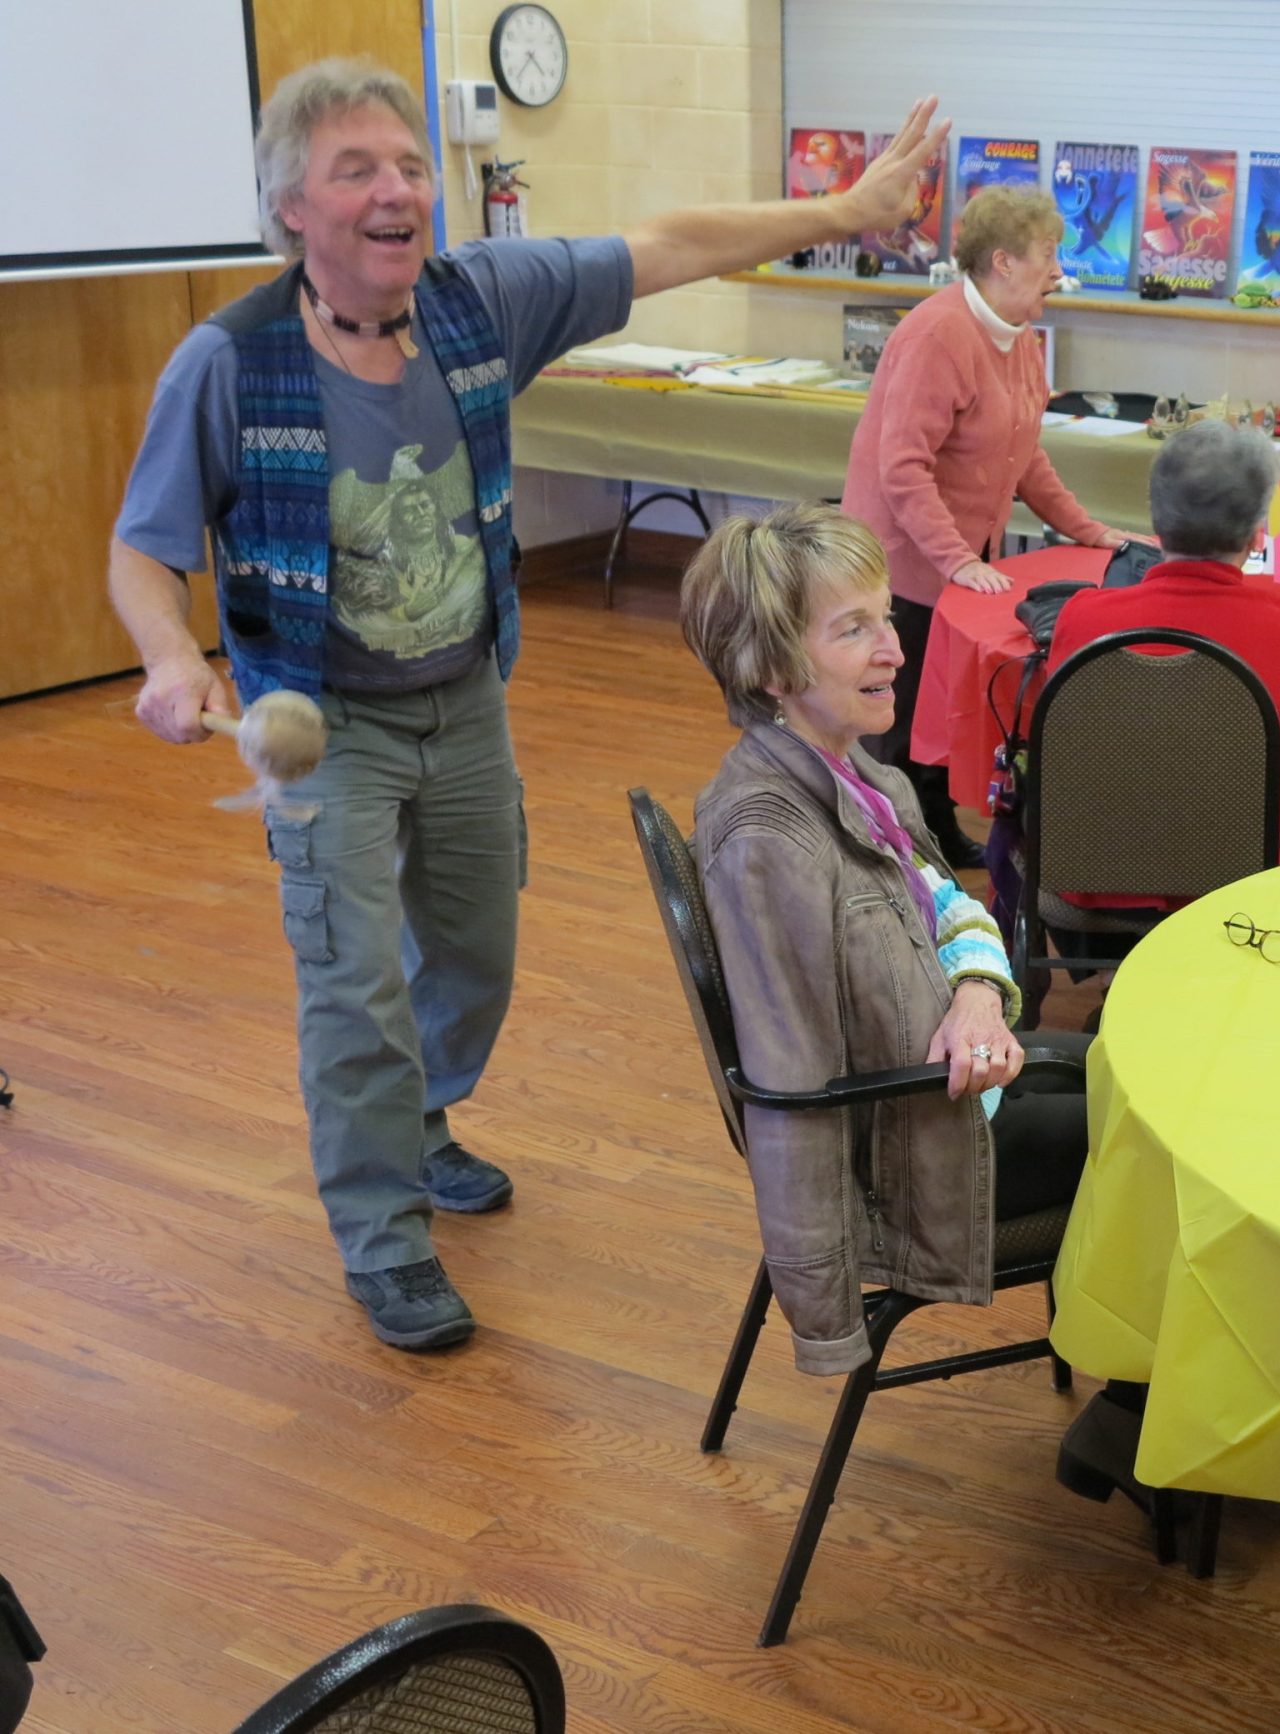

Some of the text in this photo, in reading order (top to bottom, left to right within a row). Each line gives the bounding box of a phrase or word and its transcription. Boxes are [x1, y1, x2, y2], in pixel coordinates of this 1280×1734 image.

[985, 142, 1037, 160] COURAGE
[1154, 151, 1189, 165] Sagesse
[1138, 249, 1228, 282] Sagesse
